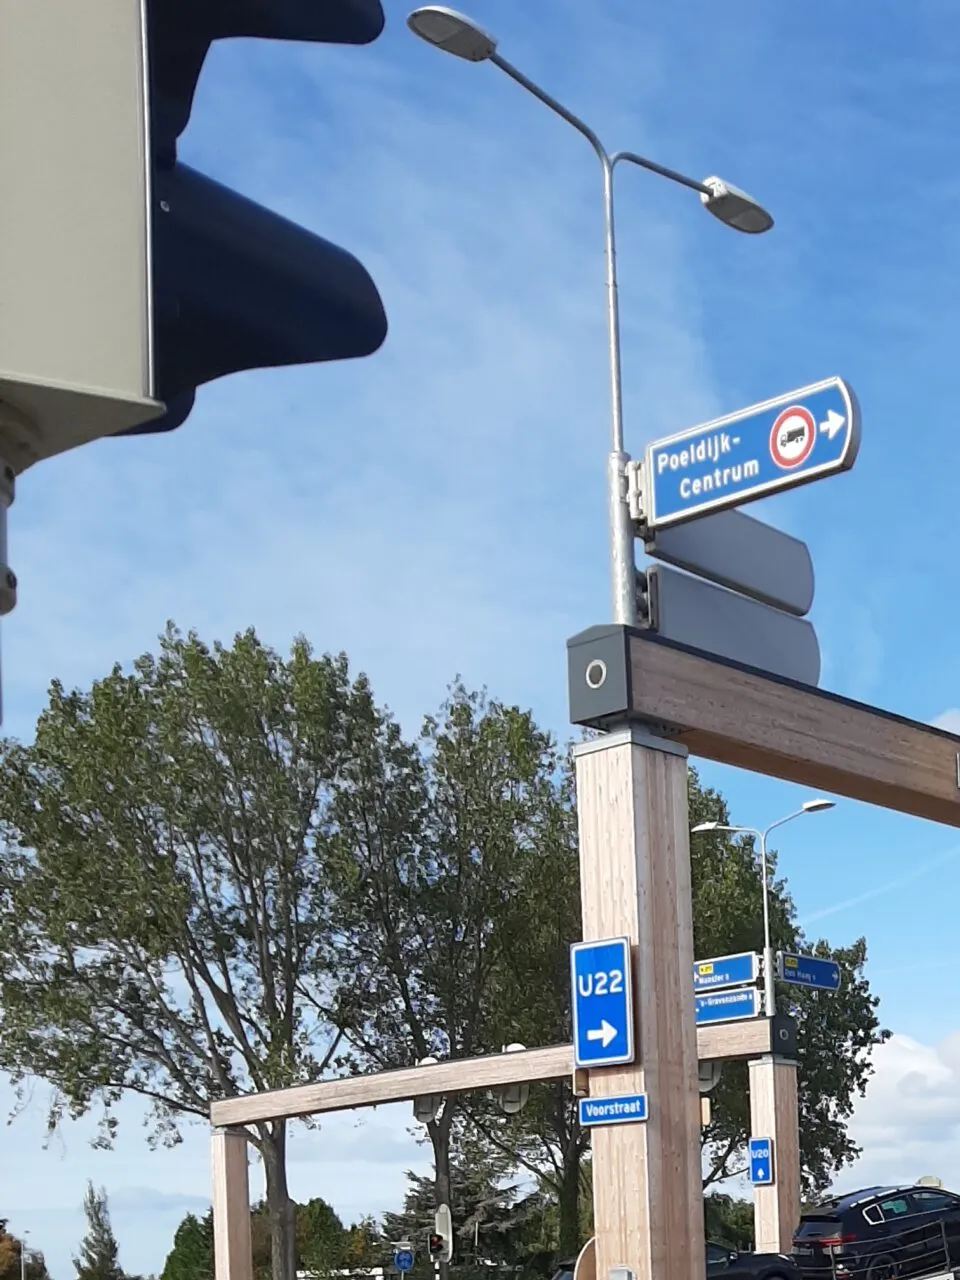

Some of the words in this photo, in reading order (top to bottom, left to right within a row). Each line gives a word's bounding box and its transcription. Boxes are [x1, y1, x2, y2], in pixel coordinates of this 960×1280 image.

[657, 432, 741, 475] Poeldijk-
[679, 457, 760, 499] Centrum
[578, 969, 624, 997] U22
[585, 1099, 641, 1117] Voorstraat
[751, 1149, 769, 1159] U20
